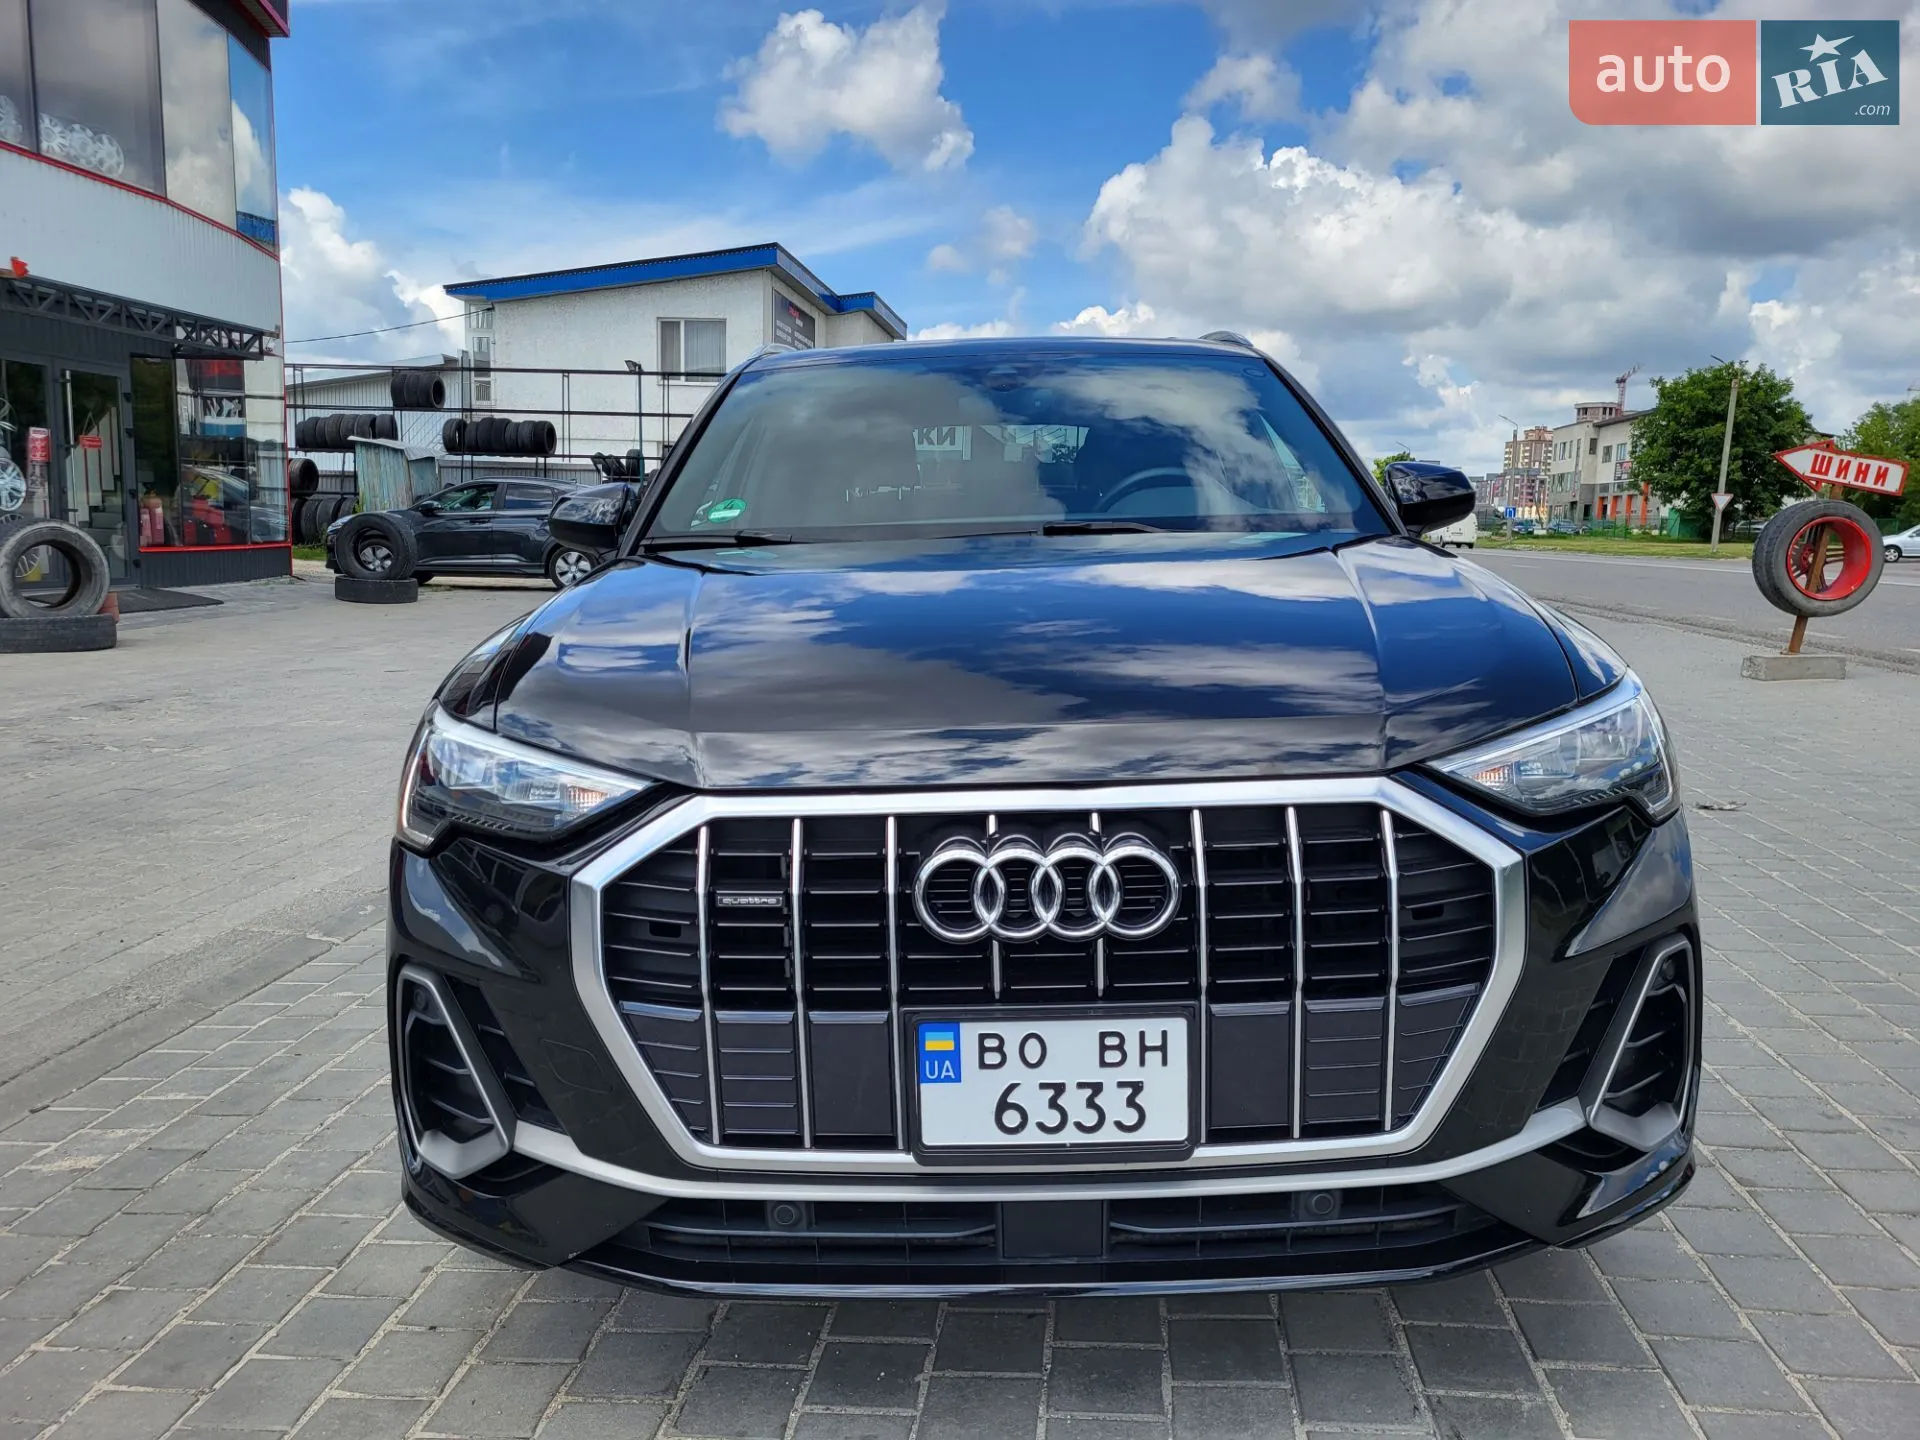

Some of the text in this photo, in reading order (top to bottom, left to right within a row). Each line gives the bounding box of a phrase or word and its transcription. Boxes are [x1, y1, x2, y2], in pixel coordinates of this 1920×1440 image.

[1809, 453, 1889, 487] ШИНИ
[722, 897, 777, 906] quattro
[1099, 1029, 1168, 1068] BH
[925, 1060, 955, 1080] UA
[994, 1080, 1146, 1135] 6333
